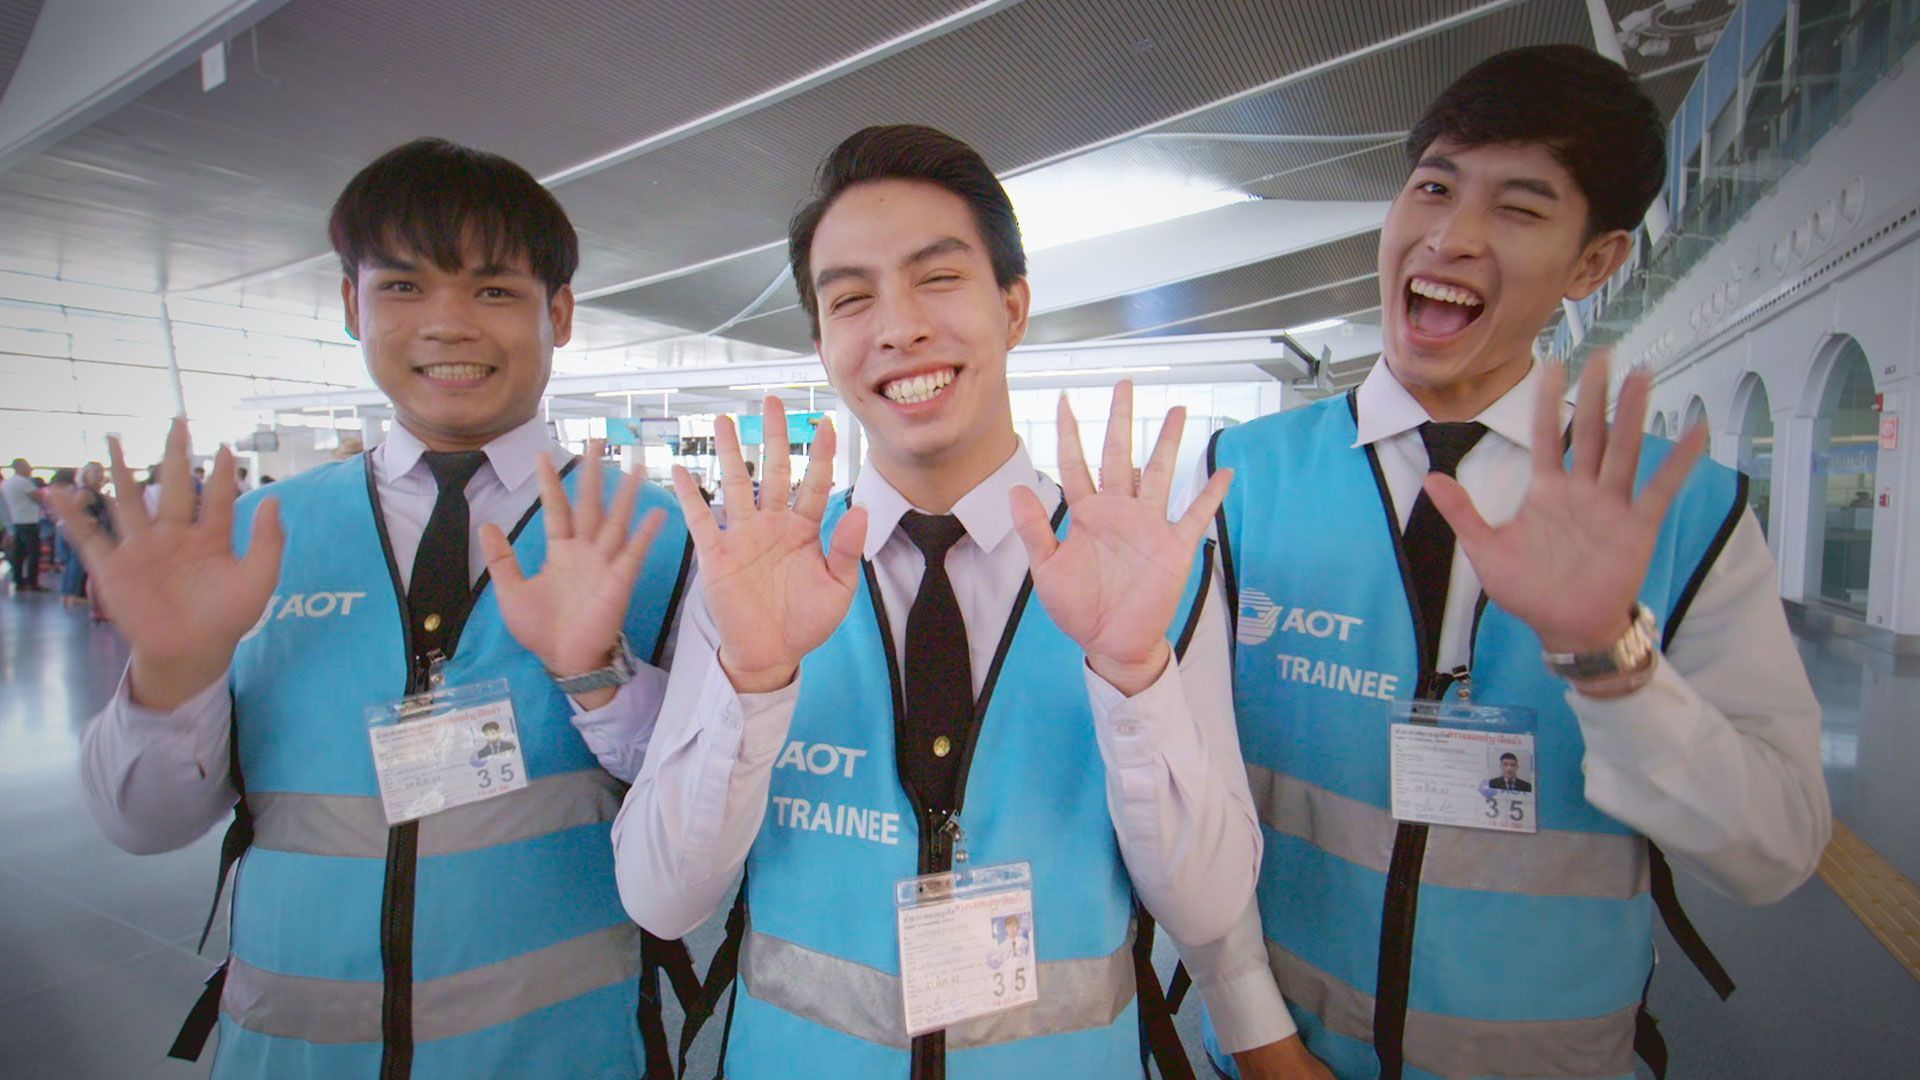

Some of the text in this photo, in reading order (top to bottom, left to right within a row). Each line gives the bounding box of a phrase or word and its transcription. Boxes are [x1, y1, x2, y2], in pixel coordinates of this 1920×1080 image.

[276, 591, 367, 620] AOT
[1279, 607, 1364, 641] AOT
[1276, 653, 1399, 701] TRAINEE
[775, 740, 868, 778] AOT
[772, 796, 900, 845] TRAINEE
